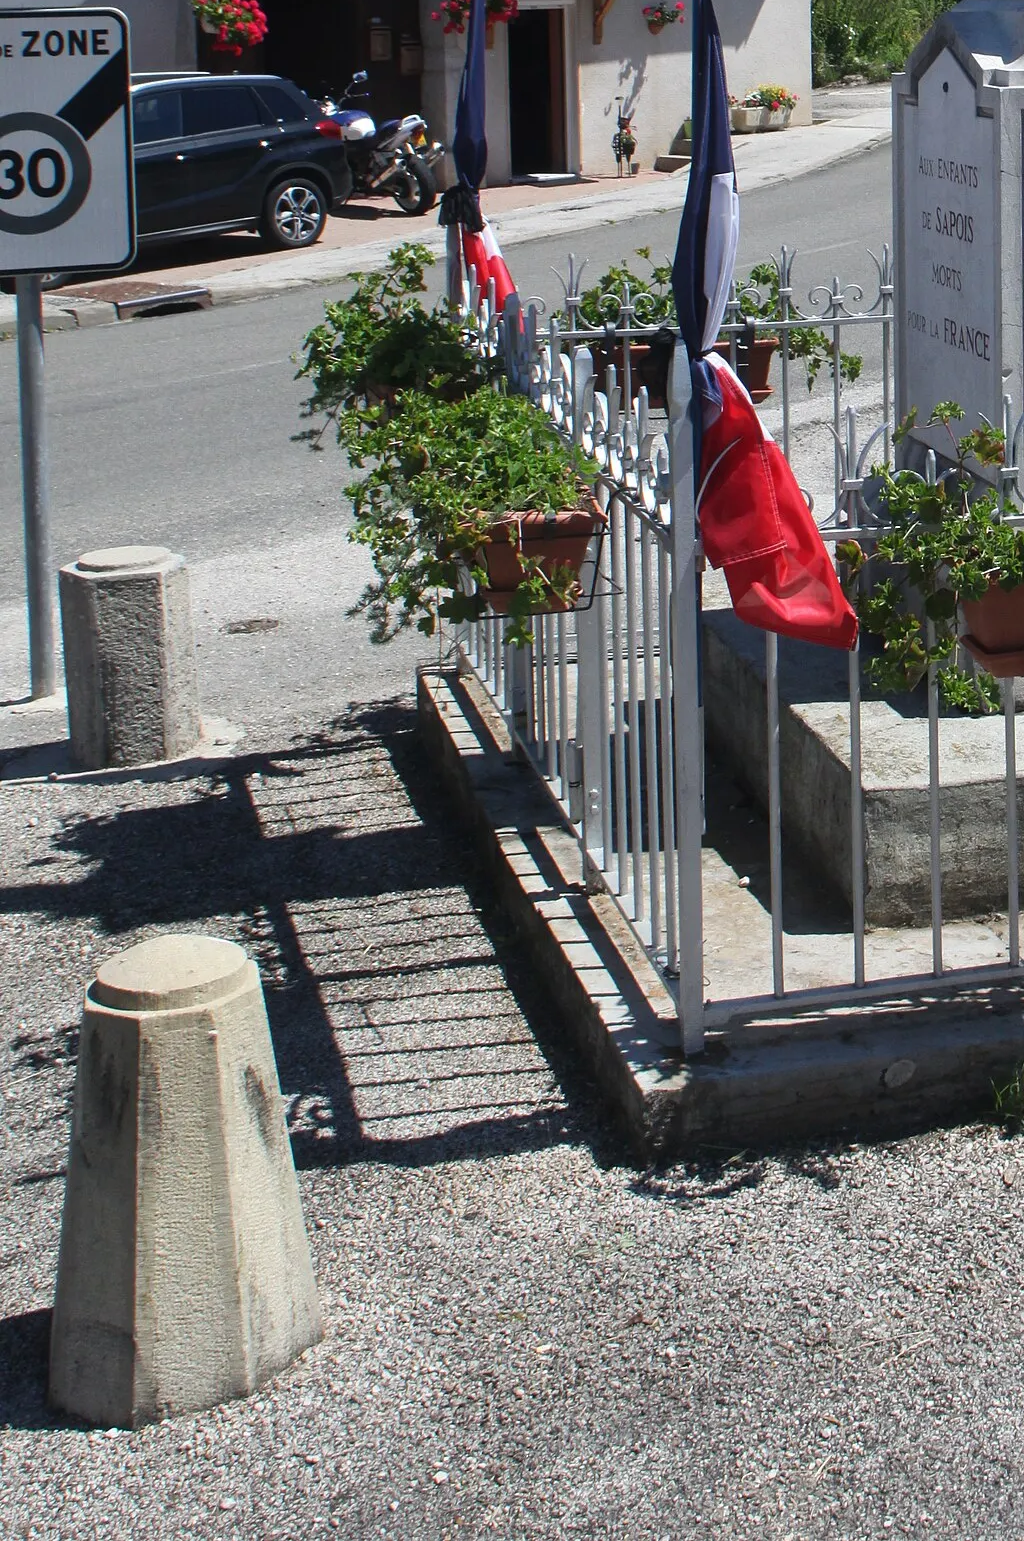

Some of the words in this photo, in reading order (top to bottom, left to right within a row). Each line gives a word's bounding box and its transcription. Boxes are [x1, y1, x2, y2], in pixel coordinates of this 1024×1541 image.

[0, 44, 13, 58] E
[21, 29, 110, 57] ZONE
[0, 148, 66, 200] 30
[919, 155, 934, 177] AUX
[938, 158, 978, 189] ENFANTS
[922, 211, 932, 230] DE
[936, 206, 974, 244] SAPOIS
[931, 262, 962, 292] MORTS
[907, 310, 927, 333] POUR
[929, 320, 940, 340] LA
[944, 317, 990, 362] FRANCE
